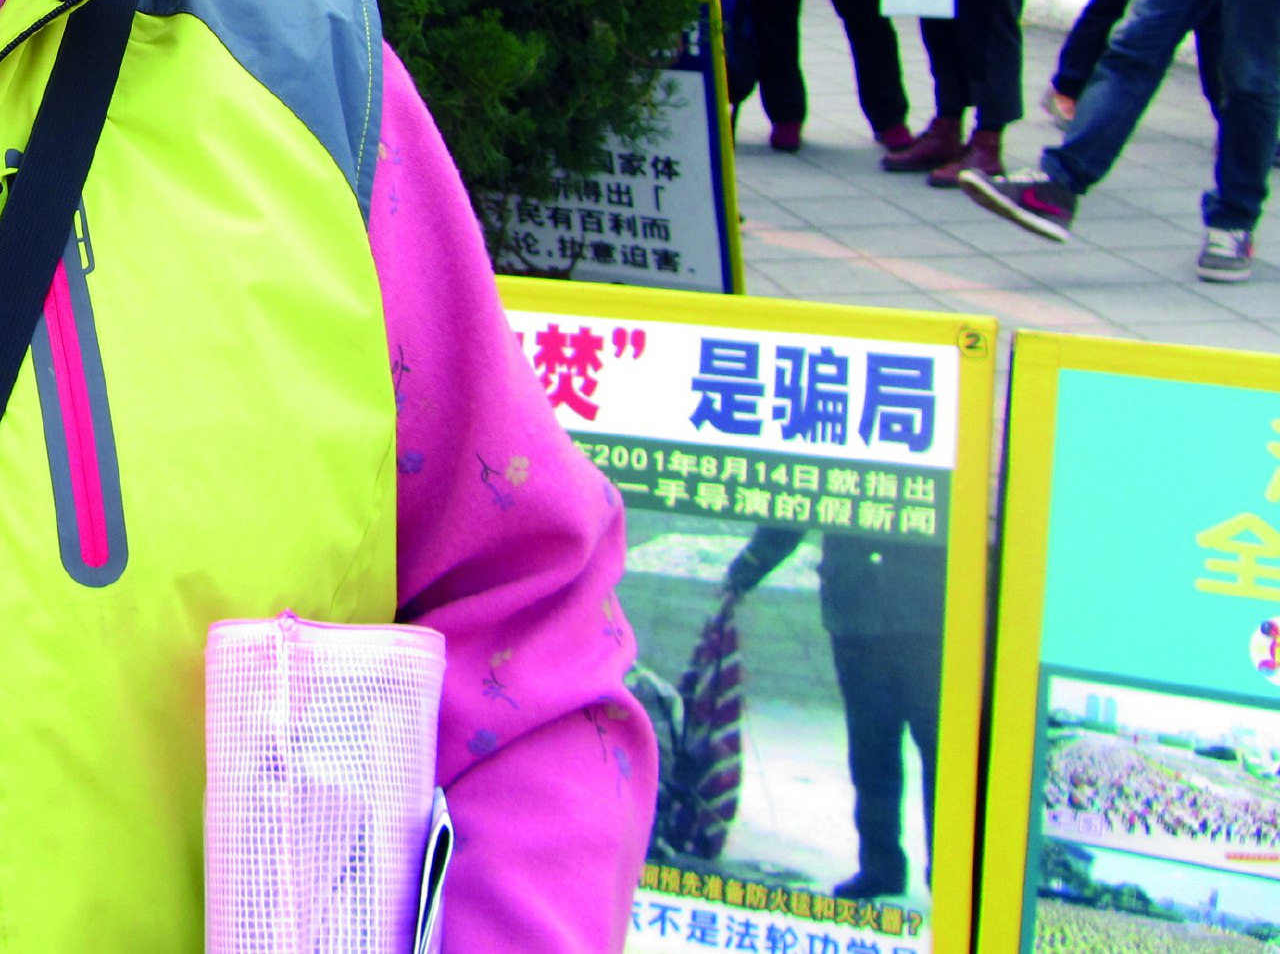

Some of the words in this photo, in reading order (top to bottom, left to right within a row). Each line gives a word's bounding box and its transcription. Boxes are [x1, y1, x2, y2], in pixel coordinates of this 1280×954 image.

[688, 336, 937, 454] 是骗局
[616, 478, 936, 536] 一手导演的假新闻
[1194, 512, 1280, 602] 全
[631, 901, 919, 954] 不是法轮功学
